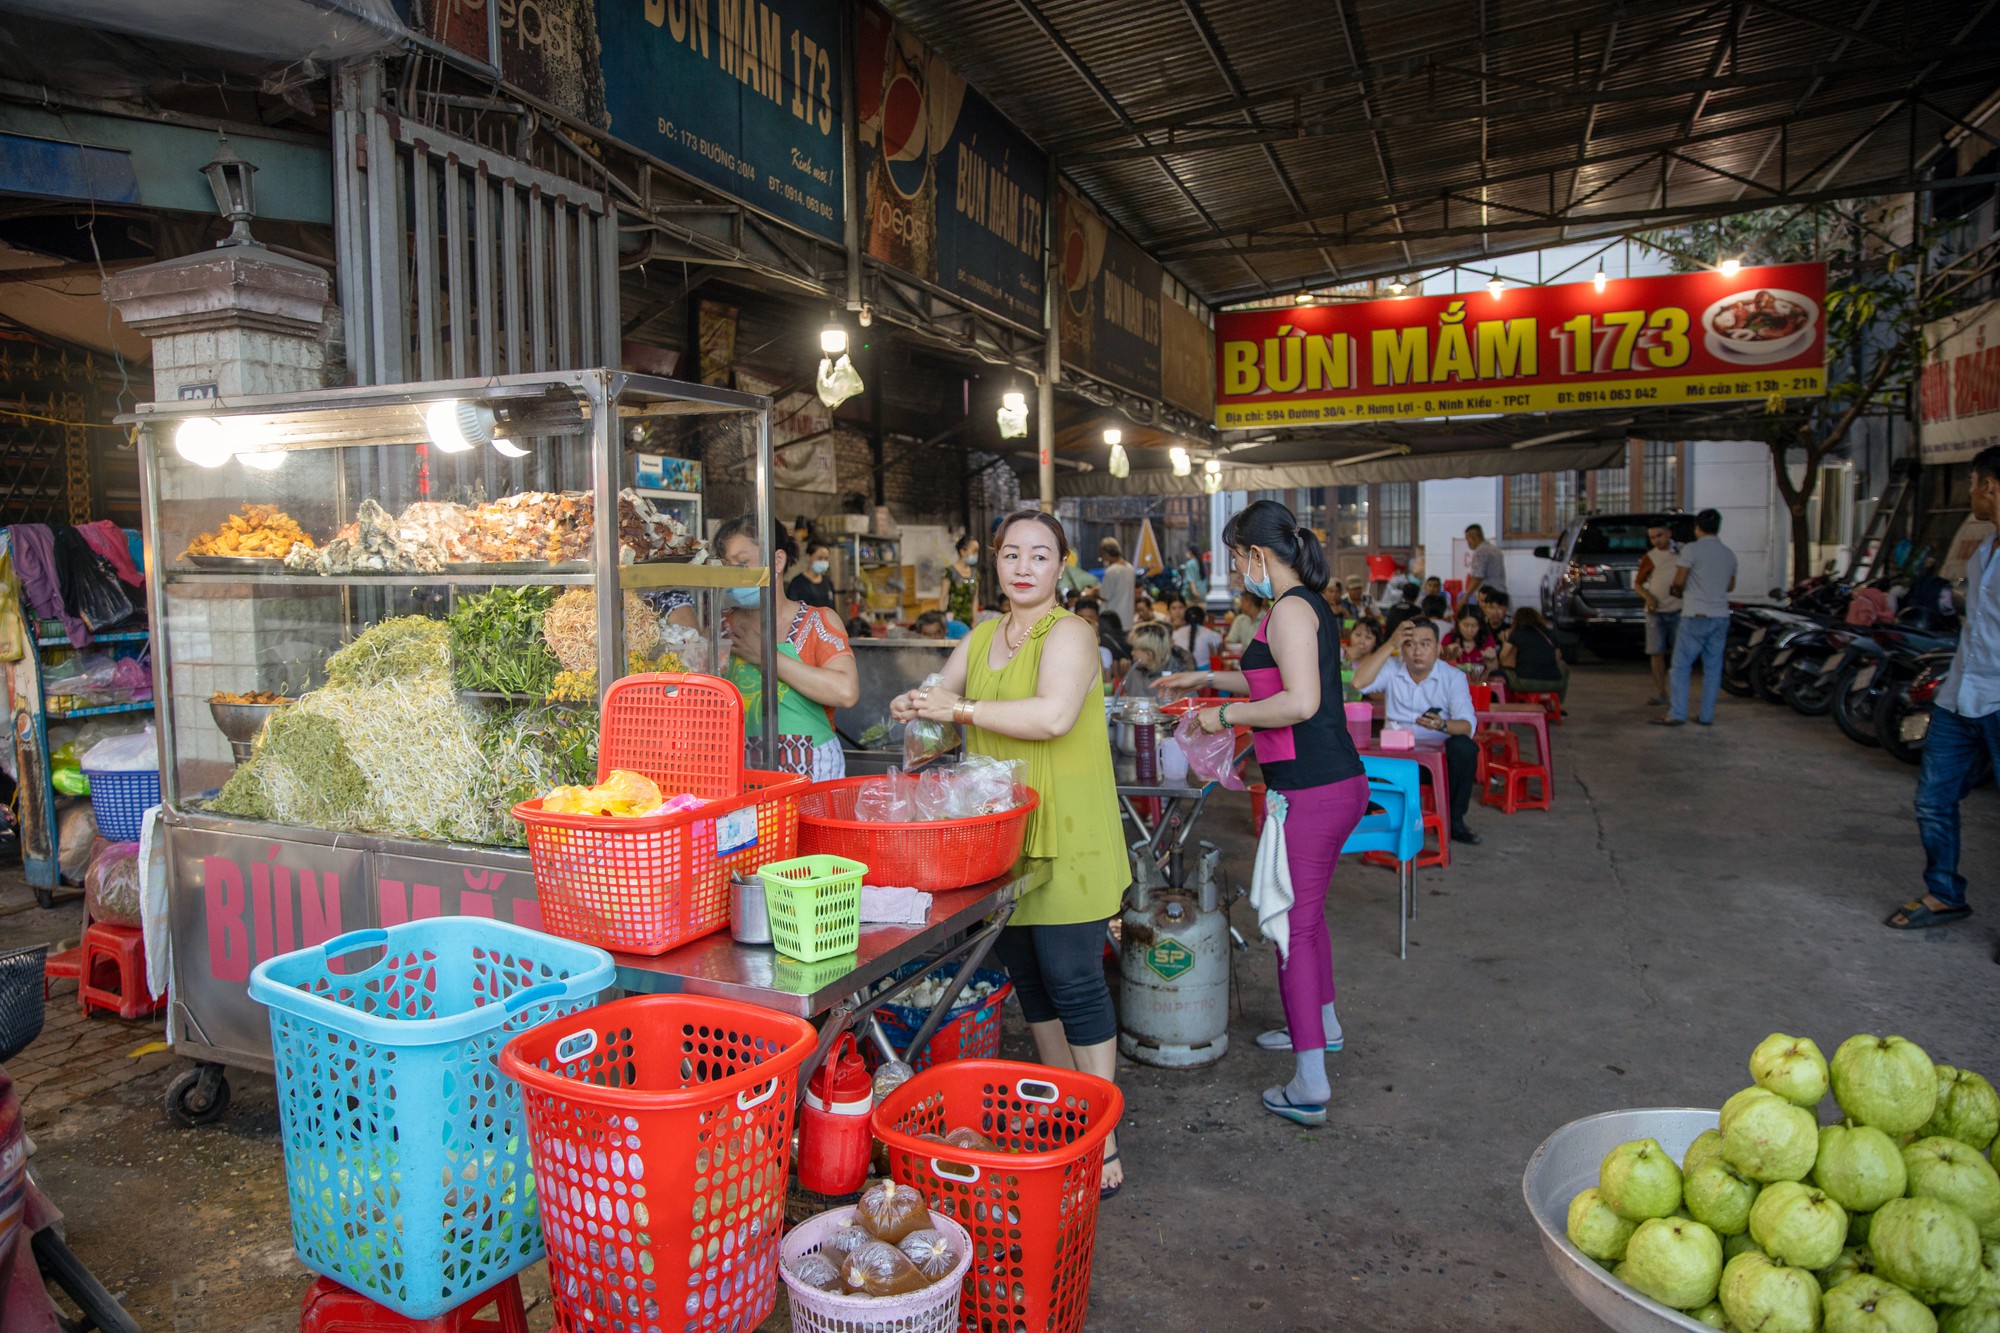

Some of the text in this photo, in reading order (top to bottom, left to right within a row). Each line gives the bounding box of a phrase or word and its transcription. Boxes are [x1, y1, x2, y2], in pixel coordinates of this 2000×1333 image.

[791, 29, 832, 136] 173
[658, 117, 755, 181] ĐC: 173 ĐƯỜNG 30/4
[768, 176, 783, 195] ĐT:
[806, 195, 820, 212] 063
[820, 204, 833, 221] 042
[955, 132, 987, 227] BÚN
[1021, 192, 1042, 261] 173
[878, 201, 925, 247] pepsi
[1224, 326, 1352, 396] BÚN
[1372, 301, 1538, 386] MẮM
[1563, 307, 1692, 375] 173
[1558, 387, 1657, 403] ĐT: 0914 063 042
[1755, 379, 1779, 392] 13h
[1793, 377, 1818, 389] 21h
[1225, 412, 1242, 424] Địa
[1244, 410, 1264, 422] chỉ:
[1266, 410, 1285, 421] 594
[1288, 407, 1320, 421] Đường
[1324, 405, 1345, 418] 30/4
[1356, 405, 1365, 416] P.
[1368, 404, 1394, 416] Hưng
[1397, 401, 1413, 415] Lợi
[1439, 399, 1464, 411] Ninh
[1503, 394, 1530, 406] TPCT
[204, 844, 345, 983] BÚN
[1154, 949, 1185, 963] SP
